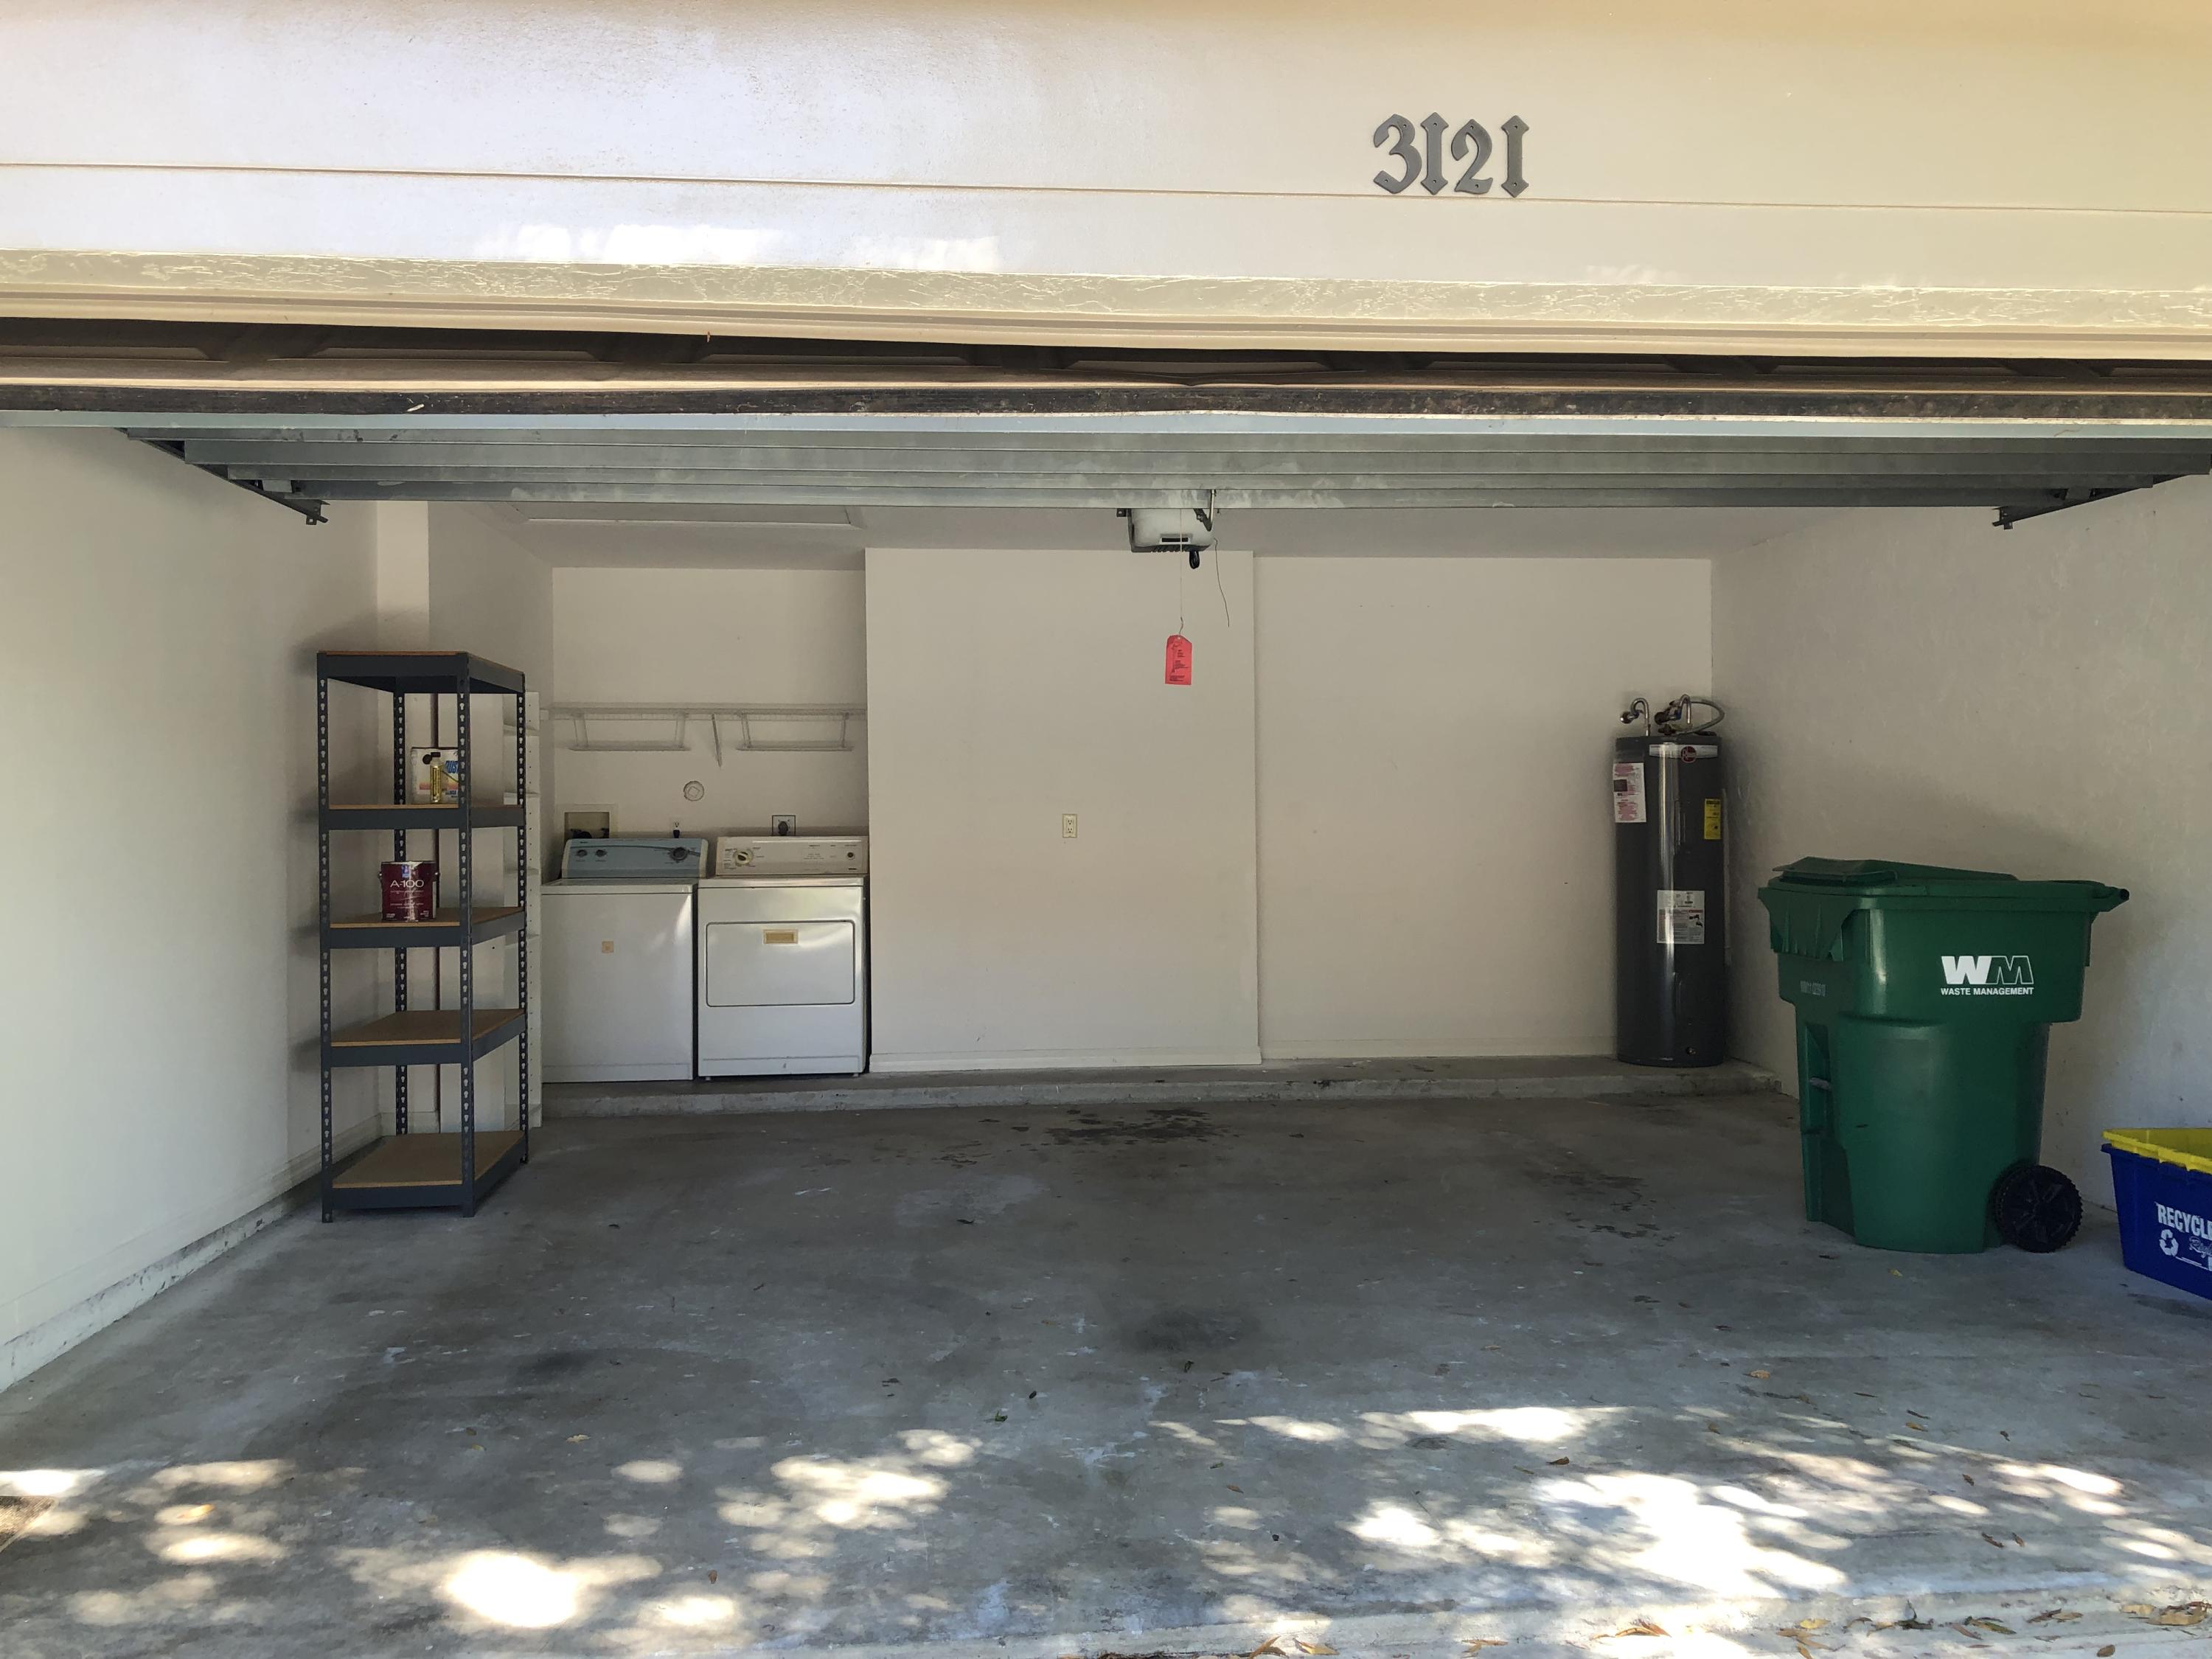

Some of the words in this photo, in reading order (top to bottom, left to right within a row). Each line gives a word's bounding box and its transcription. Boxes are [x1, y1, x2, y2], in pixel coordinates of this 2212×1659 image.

[1373, 112, 1529, 198] 3121
[390, 880, 424, 888] A-100
[1941, 956, 2034, 984] WM
[1973, 987, 2034, 995] MANAGEMENT
